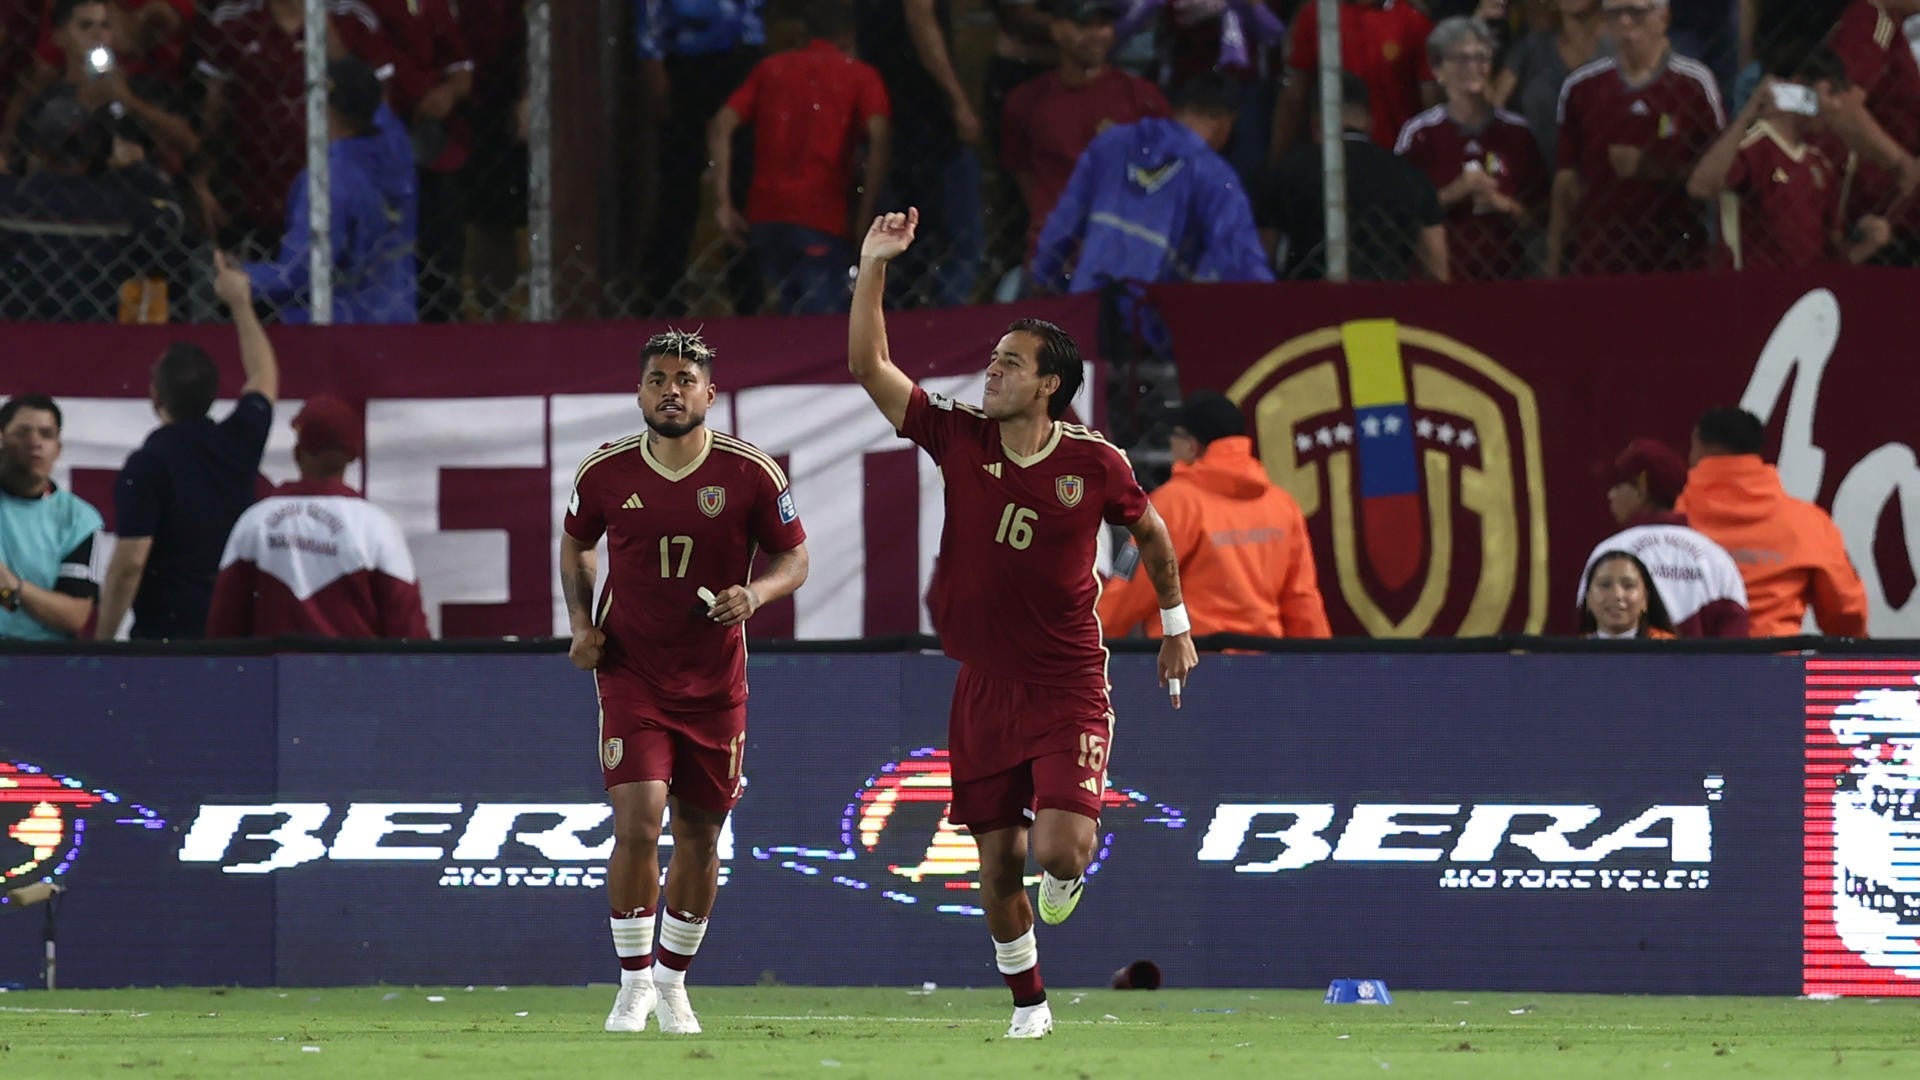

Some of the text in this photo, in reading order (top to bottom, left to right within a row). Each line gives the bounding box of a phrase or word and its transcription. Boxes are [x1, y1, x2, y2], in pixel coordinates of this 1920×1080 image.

[995, 503, 1039, 550] 16
[659, 535, 694, 578] 17
[1078, 732, 1106, 772] 16
[1198, 803, 1713, 873] BERA
[1439, 868, 1710, 891] MOTORCYCLES
